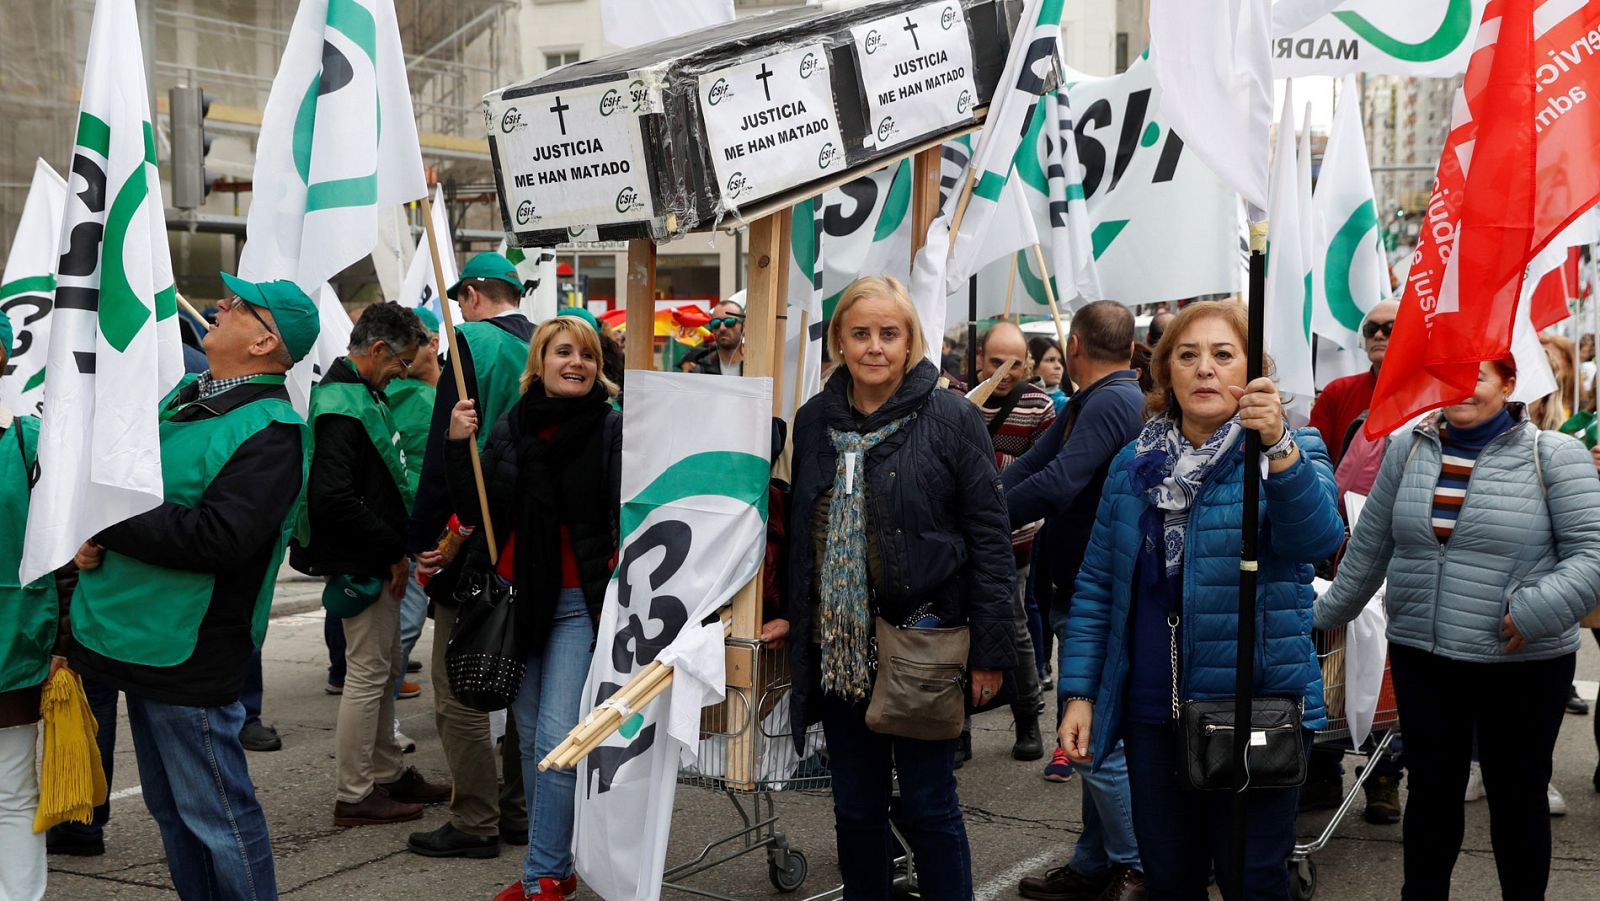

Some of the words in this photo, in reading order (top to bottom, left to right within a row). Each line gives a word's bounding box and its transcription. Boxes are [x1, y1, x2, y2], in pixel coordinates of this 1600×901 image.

[892, 50, 948, 78] JUSTICIA
[878, 90, 896, 106] ME
[898, 81, 923, 99] HAN
[925, 66, 965, 91] MATADO
[740, 100, 807, 131] JUSTICIA
[532, 138, 603, 162] JUSTICIA
[724, 144, 745, 161] ME
[748, 134, 776, 154] HAN
[777, 118, 829, 144] MATADO
[514, 173, 535, 188] ME
[538, 169, 567, 185] HAN
[570, 160, 631, 180] MATADO
